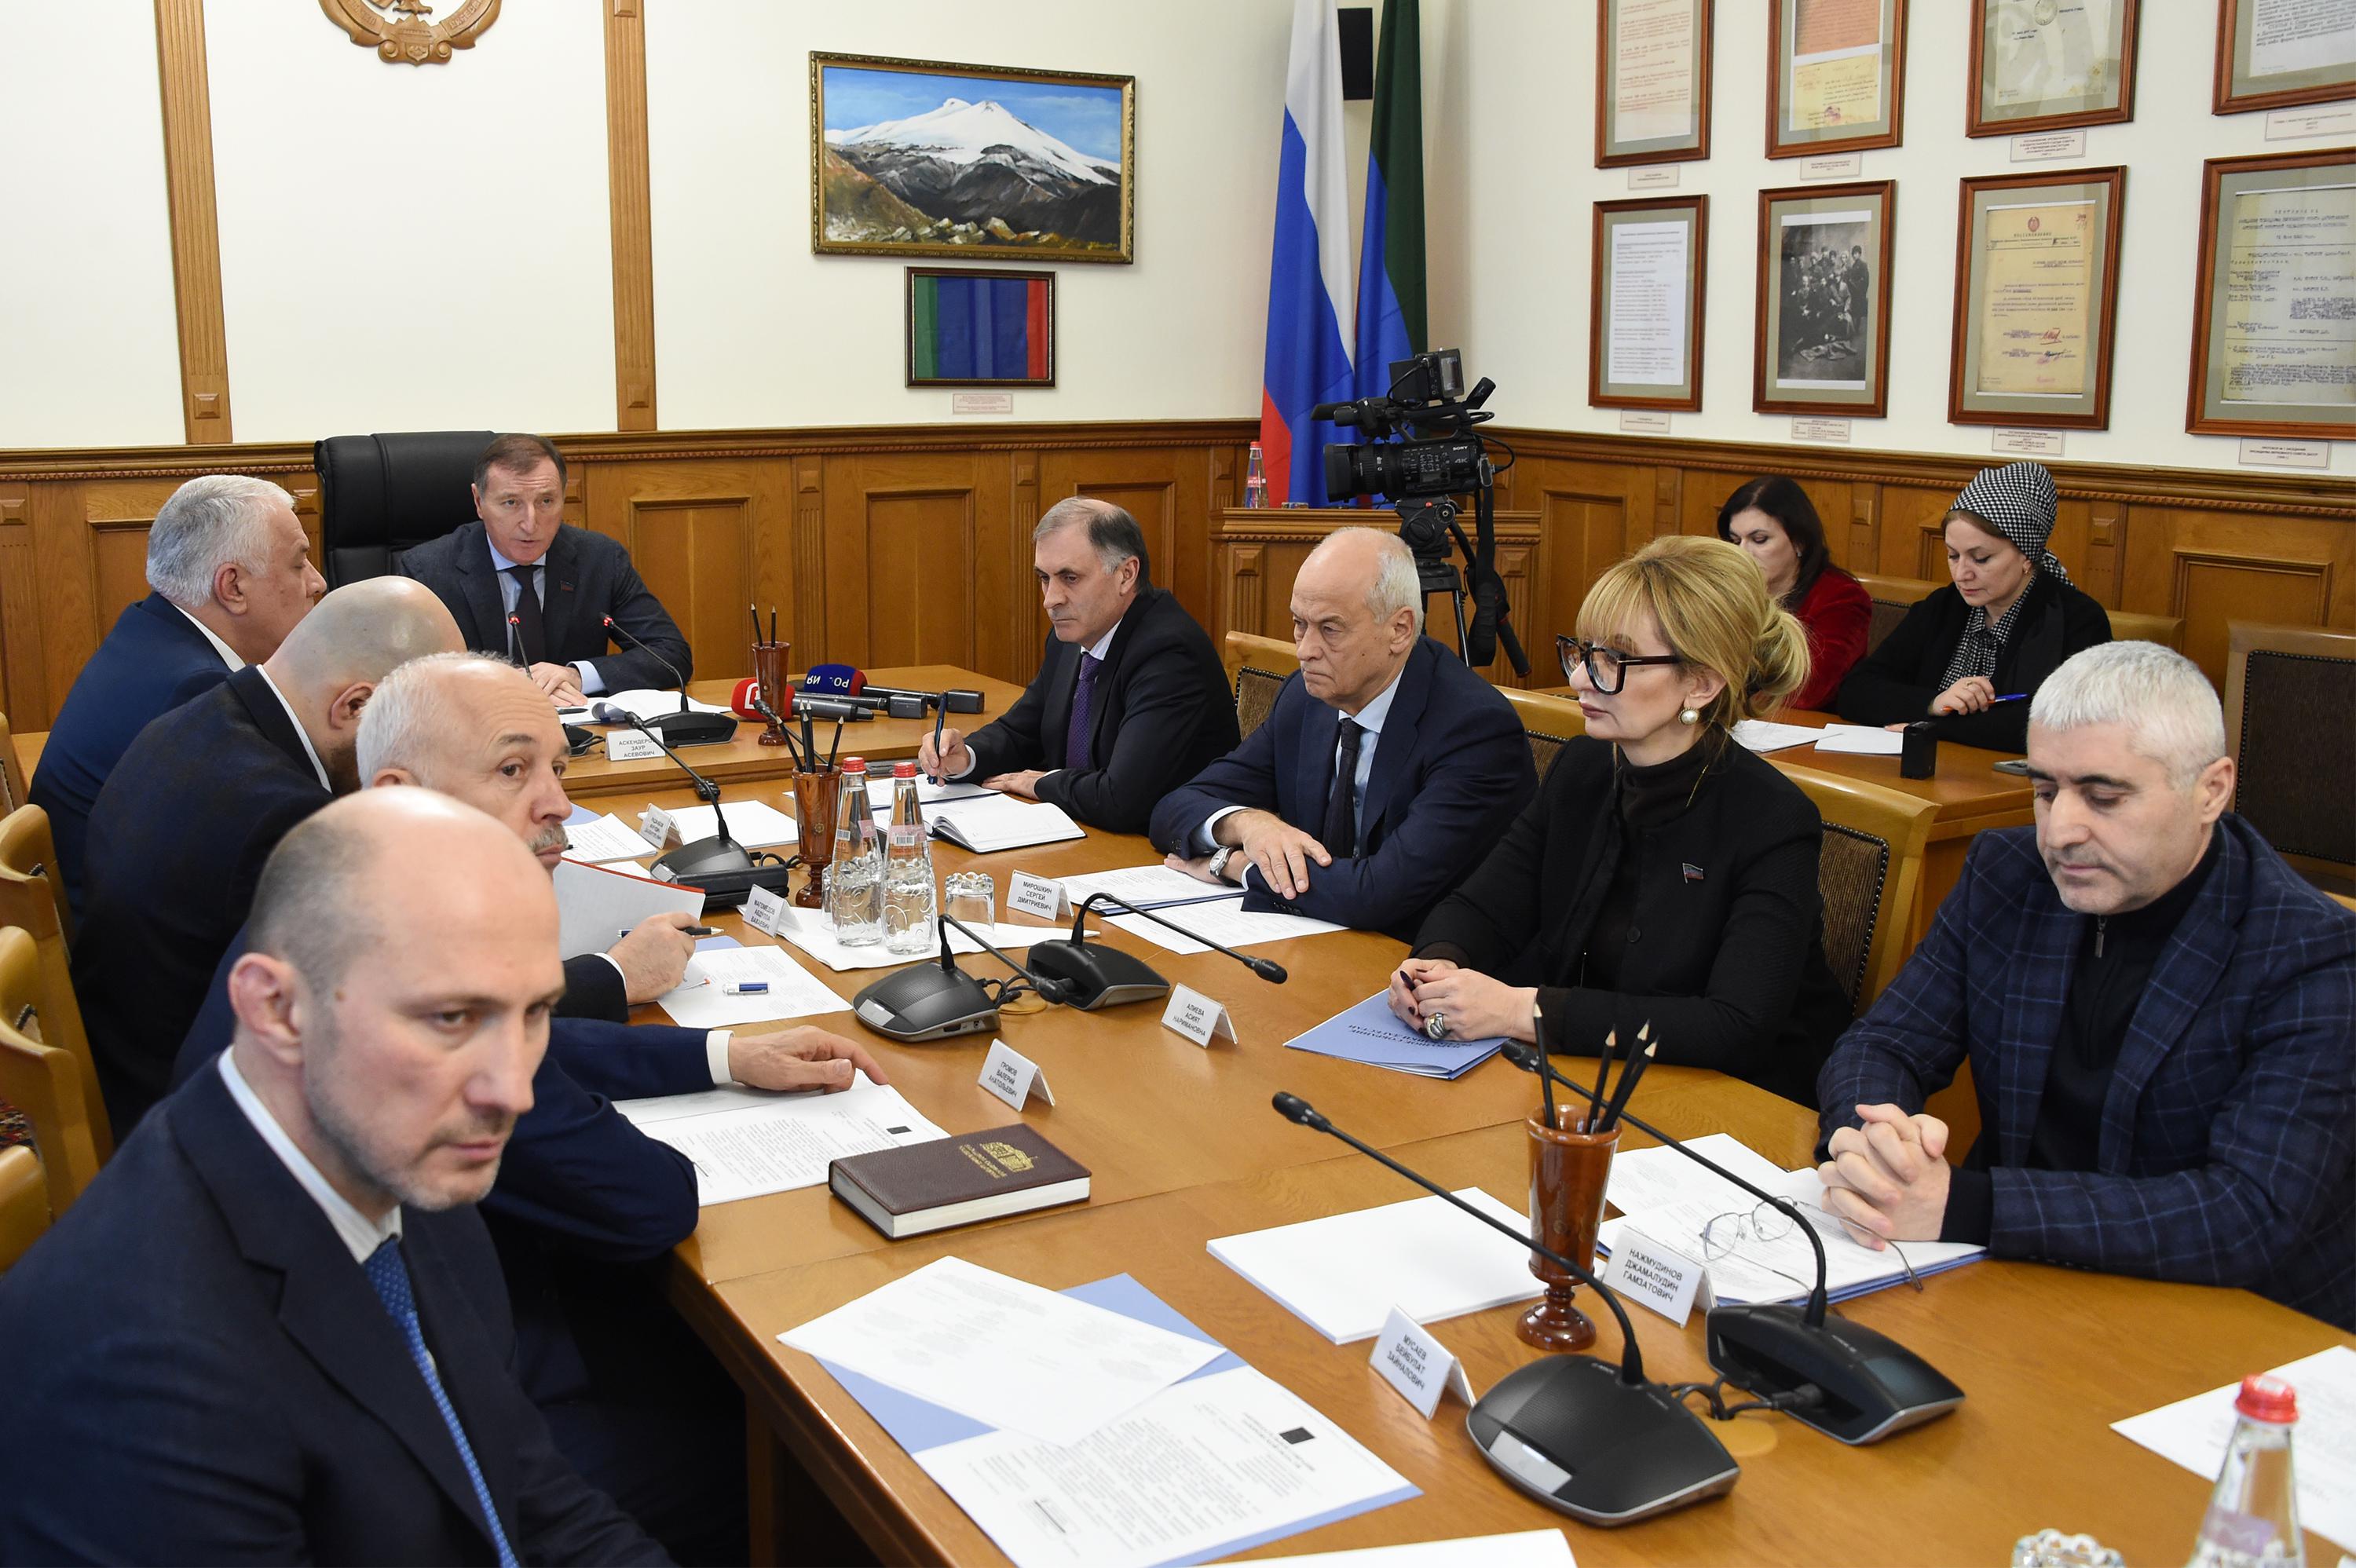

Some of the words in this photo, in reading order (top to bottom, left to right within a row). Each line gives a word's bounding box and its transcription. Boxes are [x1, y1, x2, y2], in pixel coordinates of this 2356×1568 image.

[1023, 881, 1052, 894] МИРОШКИН
[1026, 890, 1046, 902] СЕРГЕЙ
[1017, 897, 1052, 912] ДМИТРИЕВИЧ
[1184, 1012, 1201, 1024] АСИЯТ
[1186, 1003, 1205, 1018] АЛИЕВА
[1172, 1015, 1206, 1036] НАРИМАНОВНА
[1001, 1062, 1018, 1076] ГРОМОВ
[988, 1075, 1018, 1098] АНАТОЛЬЕВИЧ
[1624, 1259, 1679, 1292] ДЖАМАЛУДИН
[1629, 1248, 1682, 1281] НАЖМУДИНОВ
[1622, 1270, 1674, 1303] ГАМЗАТОВИЧ
[1403, 1333, 1427, 1361] МУСАЕВ
[1395, 1343, 1426, 1375] БЕЙБУЛАТ
[1387, 1351, 1425, 1391] ЗАЙНАЛОВИЧ
